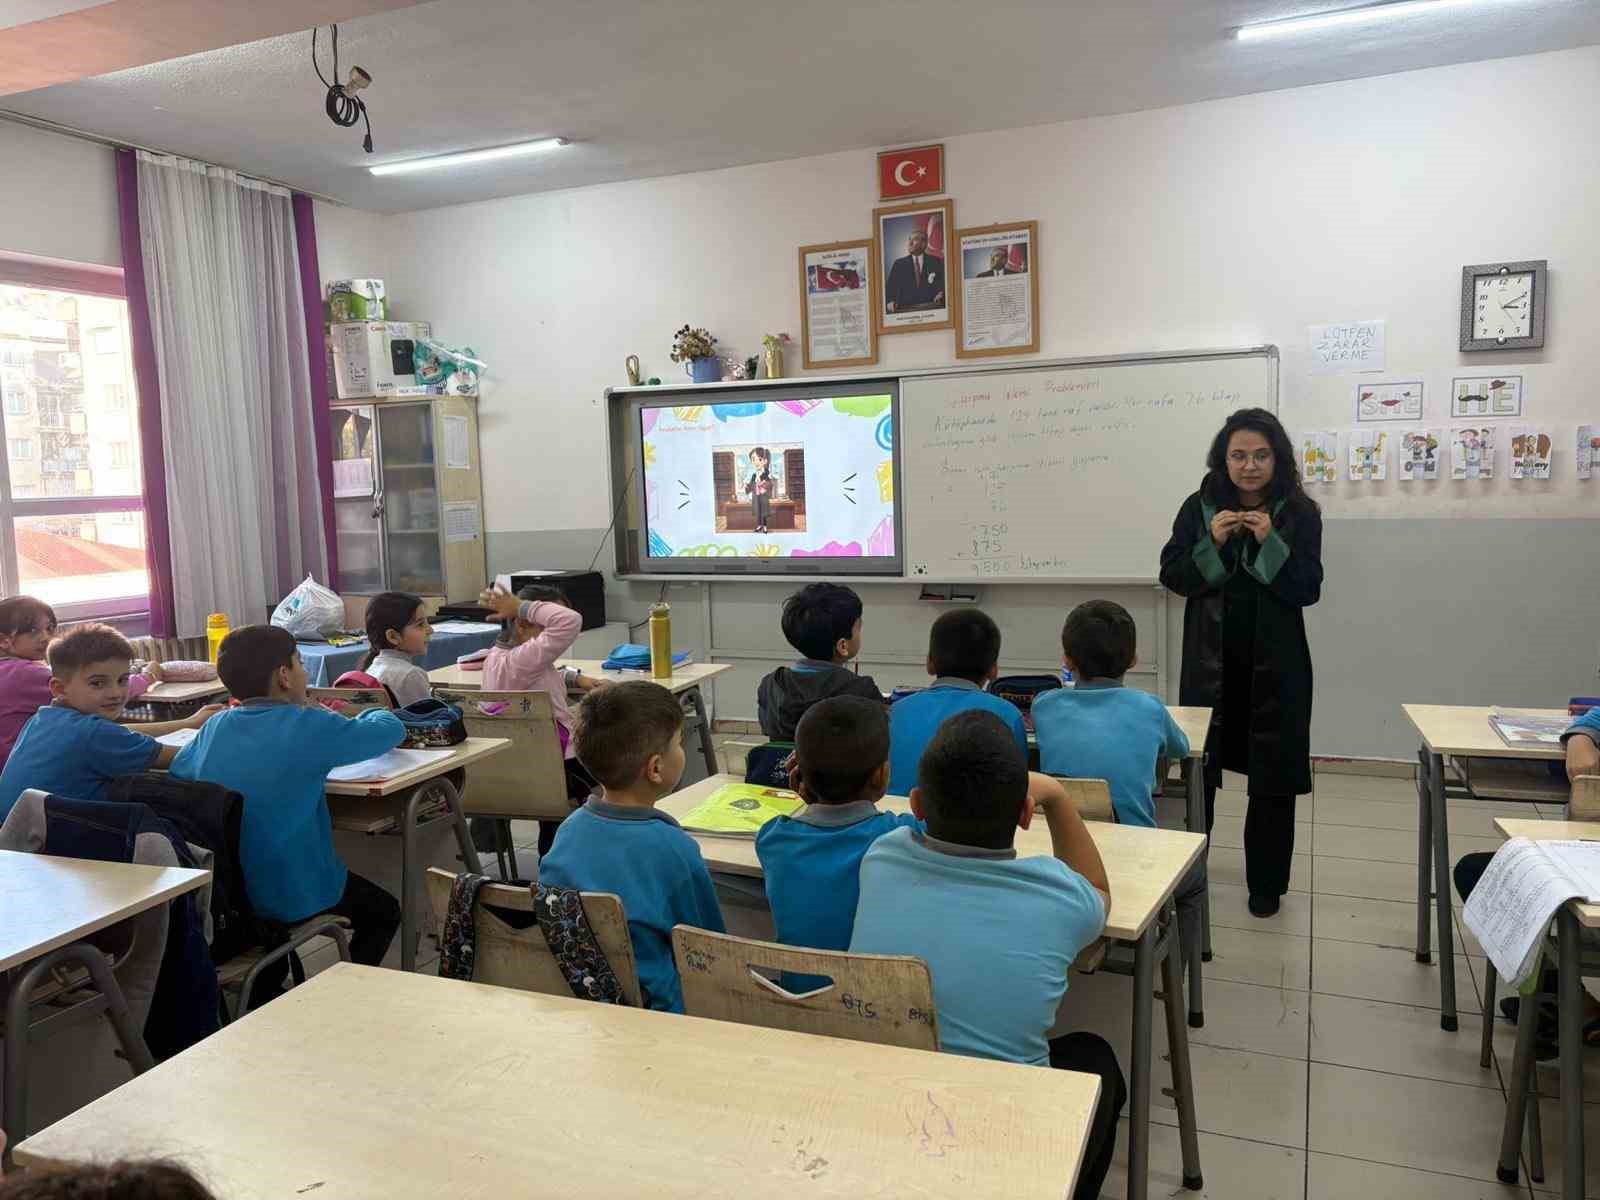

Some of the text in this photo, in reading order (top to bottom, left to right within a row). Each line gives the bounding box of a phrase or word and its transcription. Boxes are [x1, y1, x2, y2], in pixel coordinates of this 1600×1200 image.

[1317, 338, 1371, 350] ZARAR
[1321, 351, 1368, 362] VERME
[1459, 383, 1515, 413] HE
